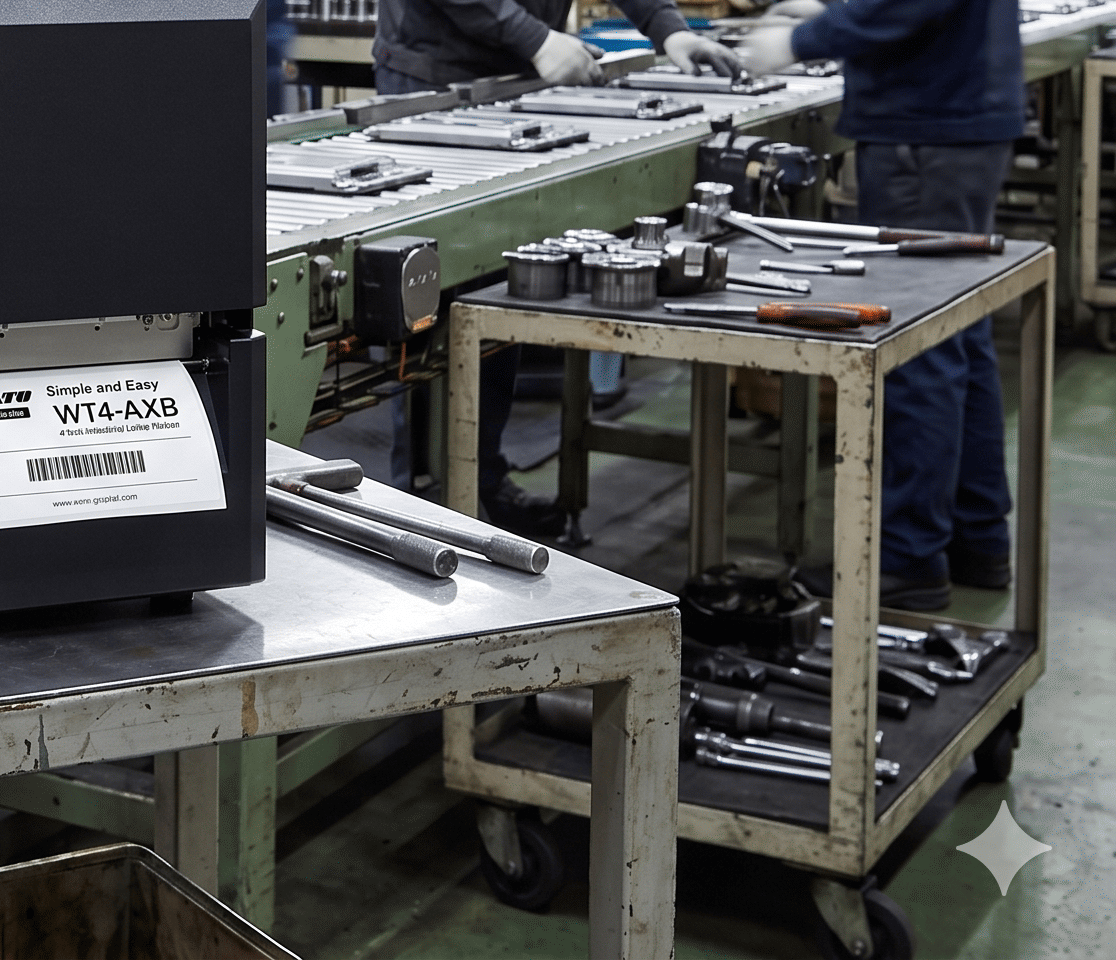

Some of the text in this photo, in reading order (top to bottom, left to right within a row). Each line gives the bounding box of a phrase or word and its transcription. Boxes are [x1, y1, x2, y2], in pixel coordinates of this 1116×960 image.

[46, 379, 159, 398] Simple and Easy
[52, 397, 179, 425] WT4-AXB
